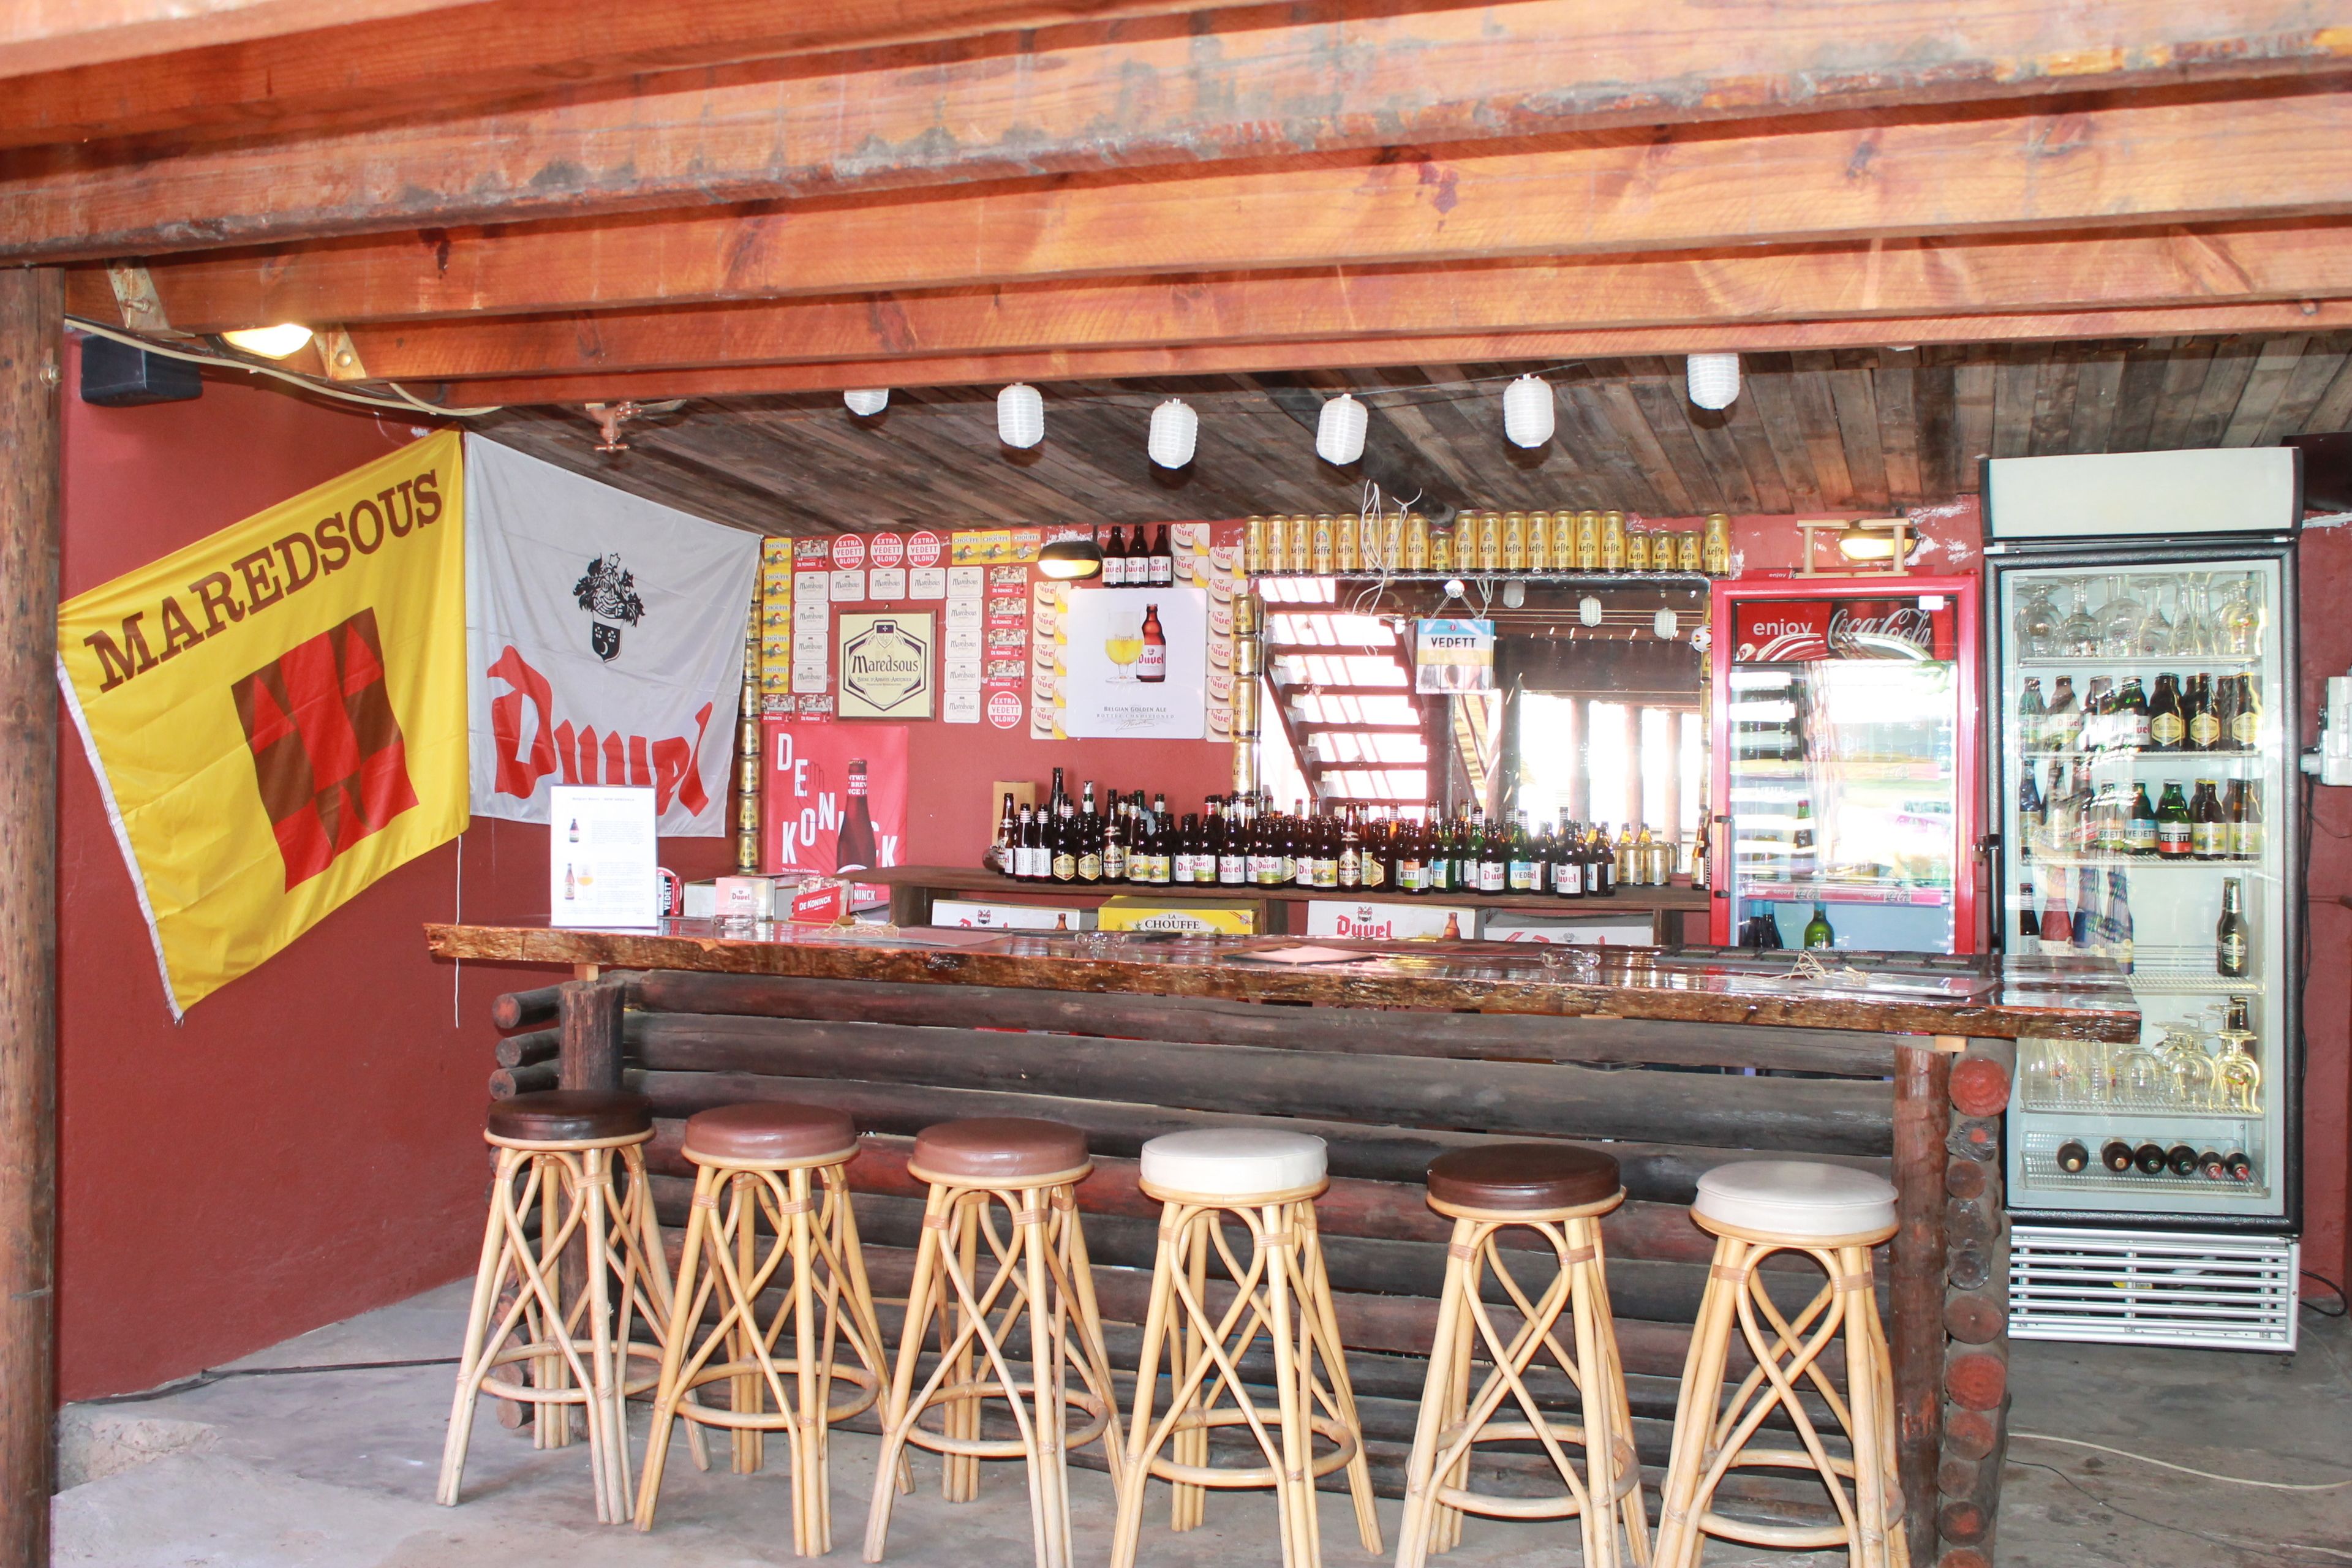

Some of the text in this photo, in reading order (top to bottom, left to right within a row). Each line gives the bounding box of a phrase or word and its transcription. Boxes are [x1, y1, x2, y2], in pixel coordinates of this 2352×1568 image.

[84, 469, 442, 694] MAREDSOUS
[1752, 618, 1813, 637] enjoy
[1827, 608, 1932, 650] Coca-Cola
[1431, 637, 1476, 648] VEDETT
[852, 654, 919, 674] Maredsous
[1138, 654, 1164, 664] Duvel
[487, 645, 713, 817] Duvel
[799, 902, 807, 911] DE
[807, 895, 832, 909] KONINCK
[1145, 919, 1200, 929] CHOUFFE
[1336, 914, 1393, 938] Duvel
